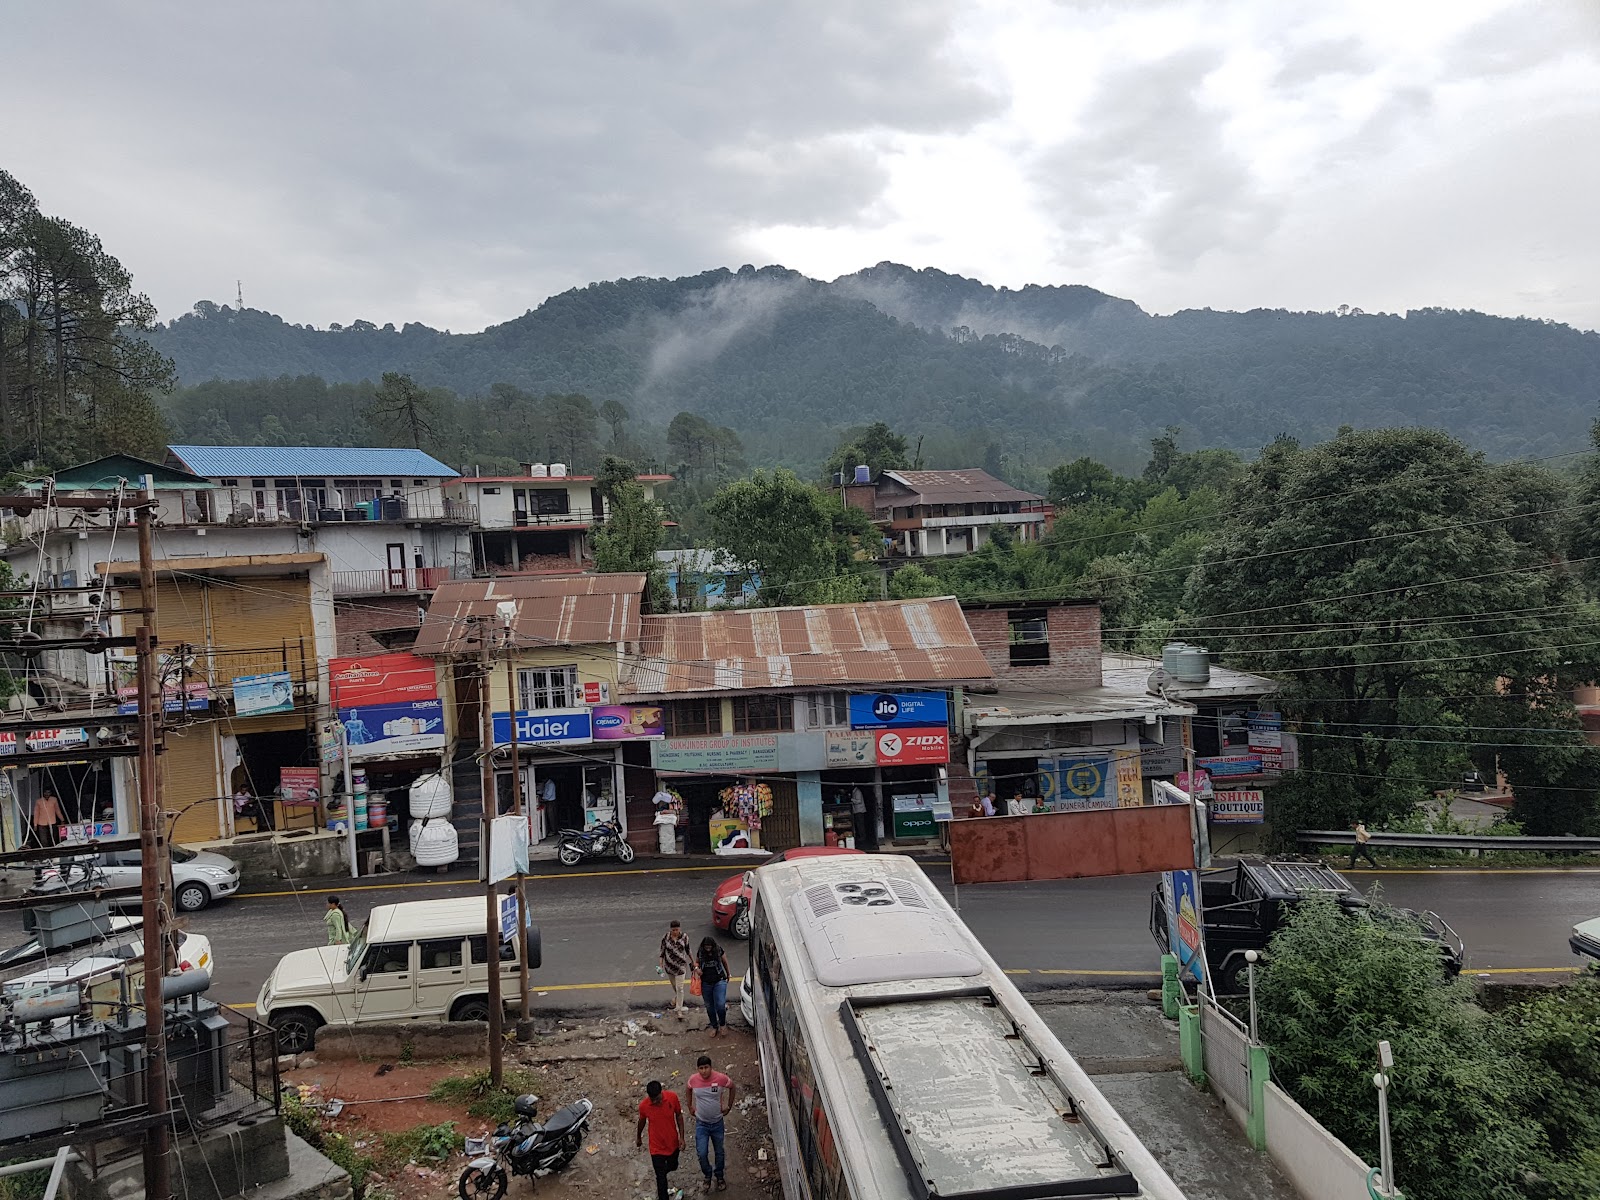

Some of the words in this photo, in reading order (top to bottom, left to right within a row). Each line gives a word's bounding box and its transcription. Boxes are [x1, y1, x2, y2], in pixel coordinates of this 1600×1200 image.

[875, 701, 897, 714] Jio
[596, 718, 620, 726] CREMICA
[516, 719, 570, 738] Haier
[669, 740, 708, 750] SUKHJINDER
[709, 739, 730, 749] GROUP
[732, 739, 739, 748] OF
[741, 737, 775, 747] INSTITUTES
[905, 735, 944, 746] ZIOX
[1214, 791, 1260, 802] ISHITA
[1060, 802, 1085, 811] DUNERA
[1088, 800, 1112, 809] CAMPUS
[1213, 803, 1263, 813] BOUTIQUE
